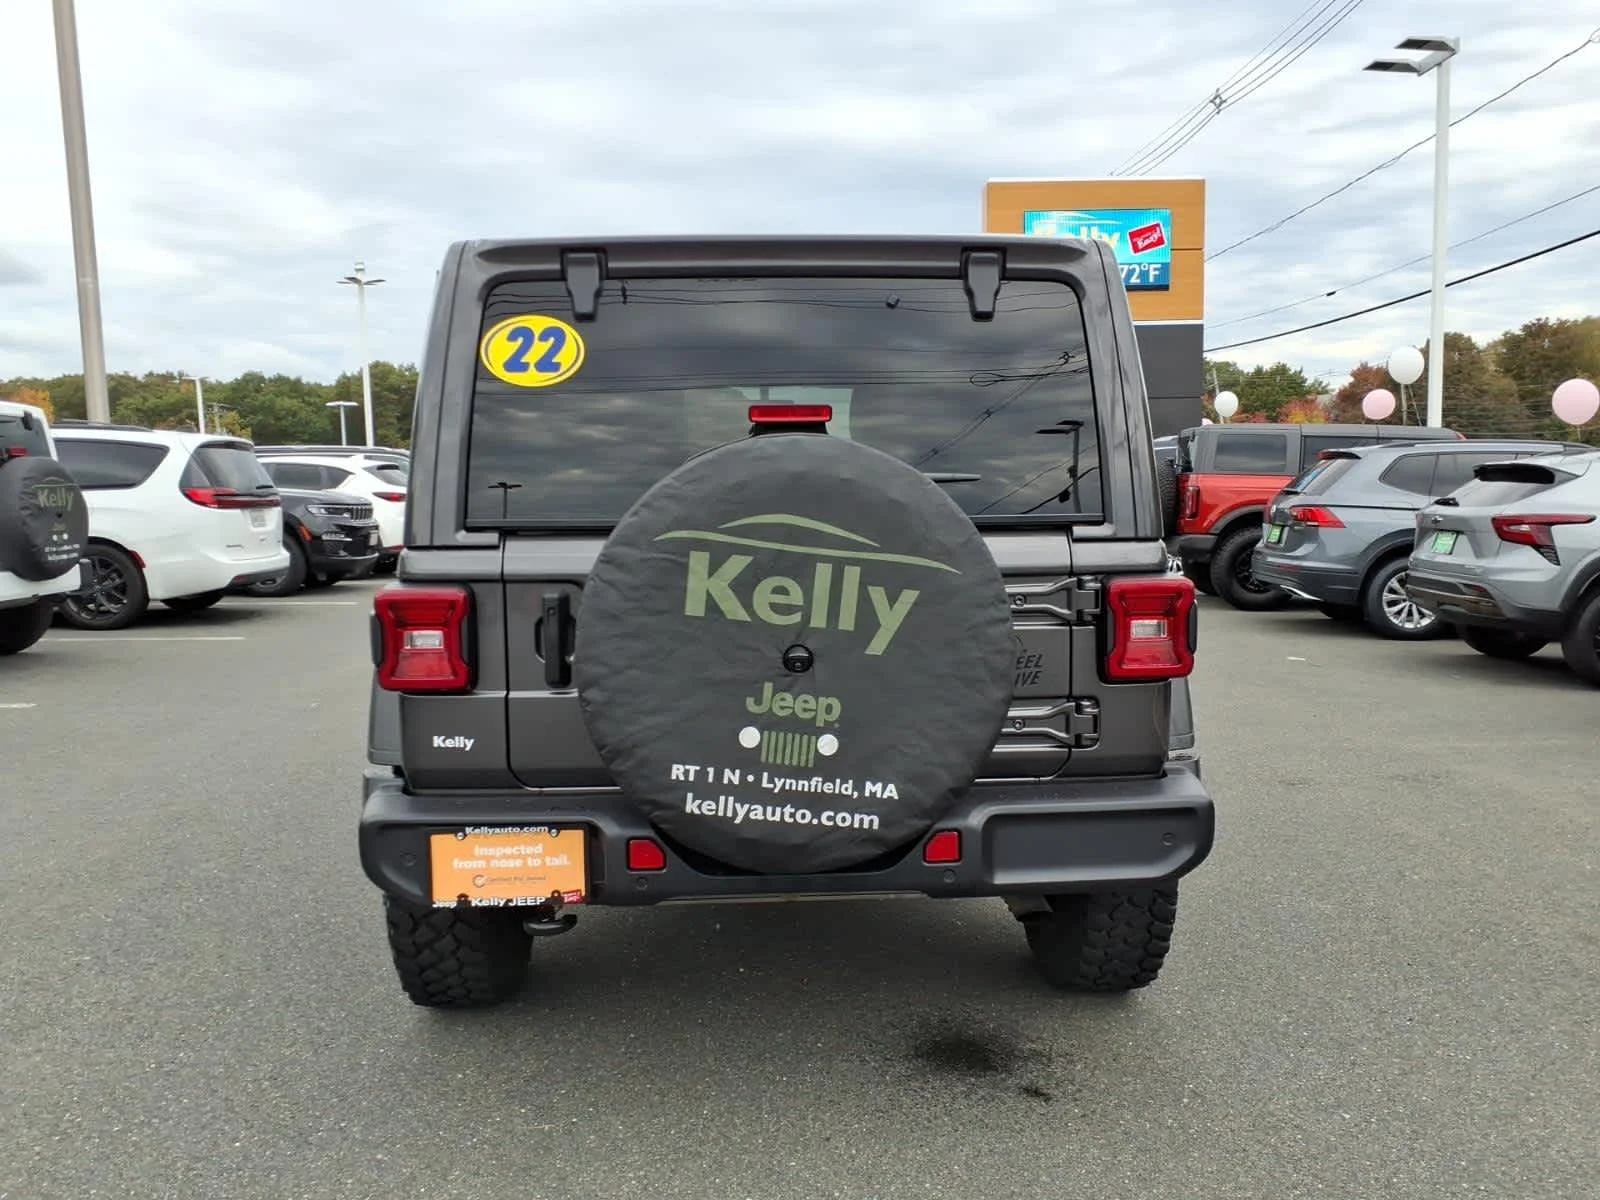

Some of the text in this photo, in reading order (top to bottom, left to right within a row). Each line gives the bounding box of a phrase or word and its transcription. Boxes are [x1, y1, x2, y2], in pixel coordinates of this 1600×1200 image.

[503, 326, 566, 373] 22
[38, 487, 74, 511] Kelly
[684, 550, 921, 656] Kelly
[1015, 654, 1043, 670] EEL
[1014, 670, 1042, 687] IVE
[745, 682, 842, 728] Jeep
[432, 735, 475, 752] Kelly
[671, 763, 900, 800] RT 1 N Lynnfield, MA
[684, 792, 880, 830] kellyauto.com
[465, 826, 548, 835] Kellyauto.com
[475, 844, 543, 857] Inspected
[453, 859, 486, 870] from
[490, 859, 524, 869] nose
[527, 857, 540, 867] to
[471, 896, 509, 908] Kelly
[508, 896, 547, 907] JEEP
